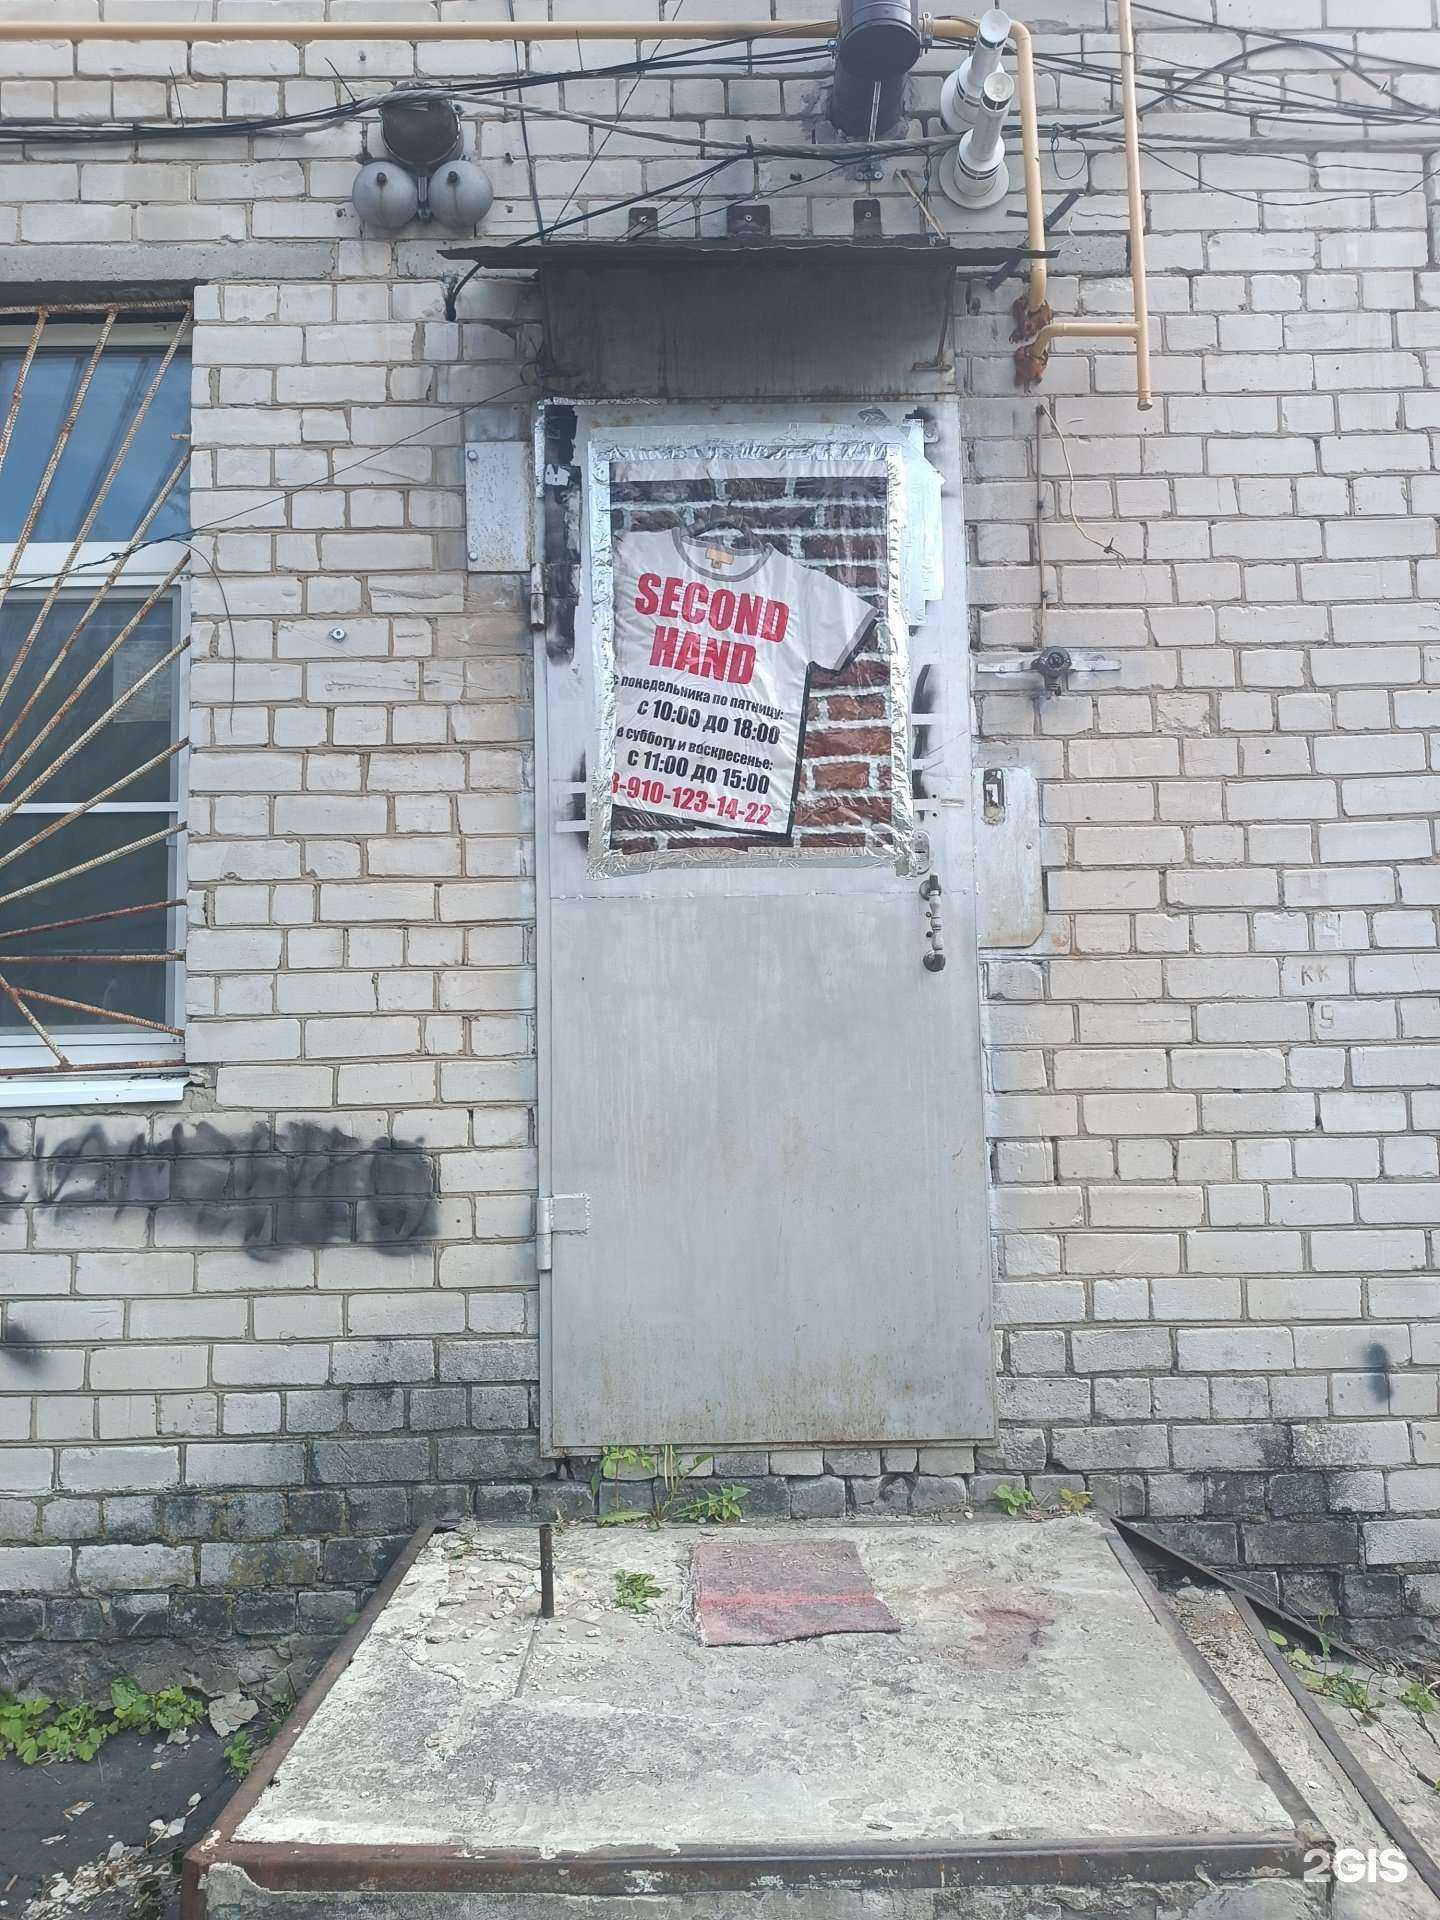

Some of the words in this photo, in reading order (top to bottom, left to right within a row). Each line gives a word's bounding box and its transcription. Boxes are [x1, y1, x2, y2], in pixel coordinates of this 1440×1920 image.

[635, 572, 789, 643] SECOND
[649, 625, 756, 685] HAND
[621, 675, 709, 704] понедельника
[713, 694, 727, 706] по
[730, 697, 784, 720] пятницу:
[637, 700, 649, 716] с
[653, 700, 700, 728] 10:00
[702, 715, 728, 733] до
[734, 717, 780, 745] 18:00
[617, 727, 624, 737] в
[626, 727, 676, 749] субботу
[677, 740, 687, 750] и
[688, 742, 774, 771] воскресенье:
[644, 751, 688, 777] 11:00
[690, 764, 717, 783] до
[722, 768, 769, 794] 15:00
